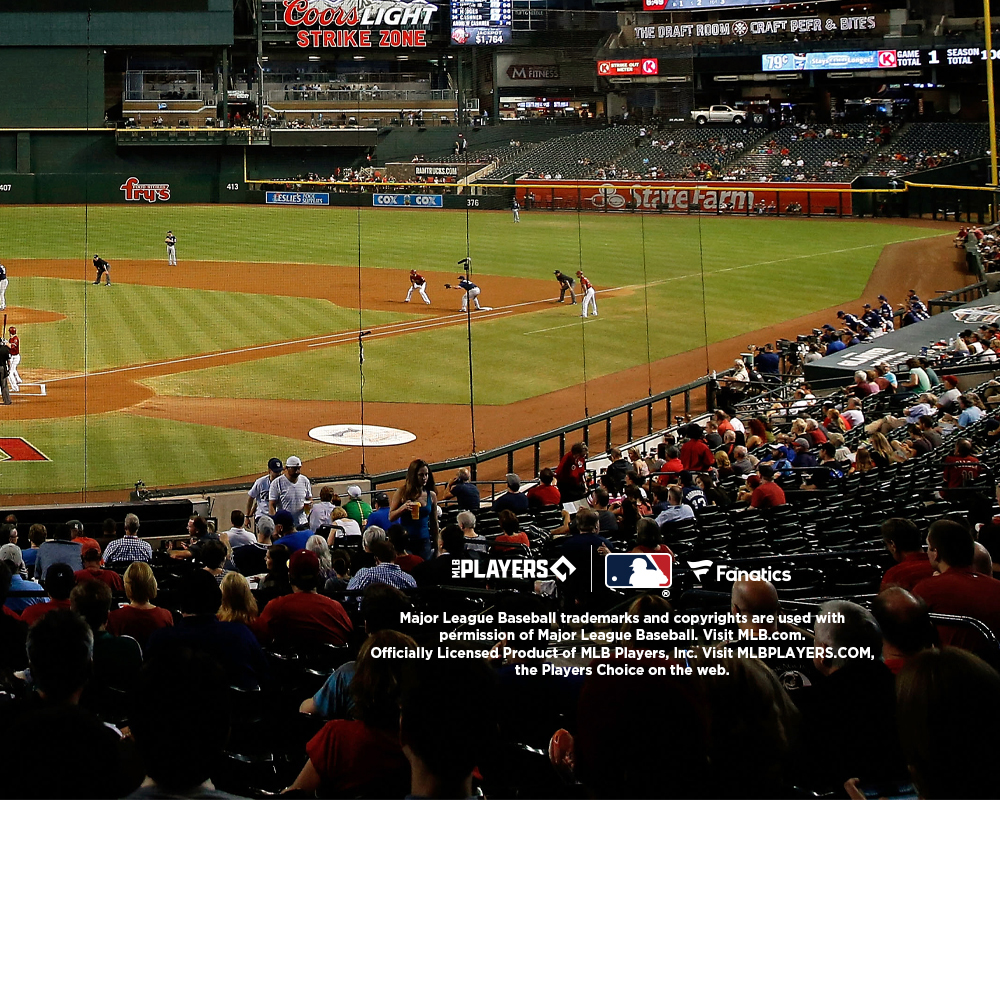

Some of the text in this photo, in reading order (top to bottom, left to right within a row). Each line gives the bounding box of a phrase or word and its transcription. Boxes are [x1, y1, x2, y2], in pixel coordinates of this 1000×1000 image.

[360, 7, 438, 25] LIGHT
[634, 16, 875, 38] THE DRAFT ROOM CRAFT BEER & BITES
[297, 30, 426, 47] STRIKE ZONE
[897, 50, 919, 58] GAME
[928, 50, 939, 64] 1
[947, 48, 979, 57] SEASON
[897, 58, 921, 66] TOTAL
[947, 57, 973, 65] TOTAL
[0, 184, 11, 192] 407
[120, 177, 170, 203] fry's
[227, 183, 238, 191] 413
[274, 193, 301, 202] LESLIE'S
[378, 195, 436, 206] COX COX
[630, 185, 754, 209] State Farm
[467, 198, 479, 207] 376
